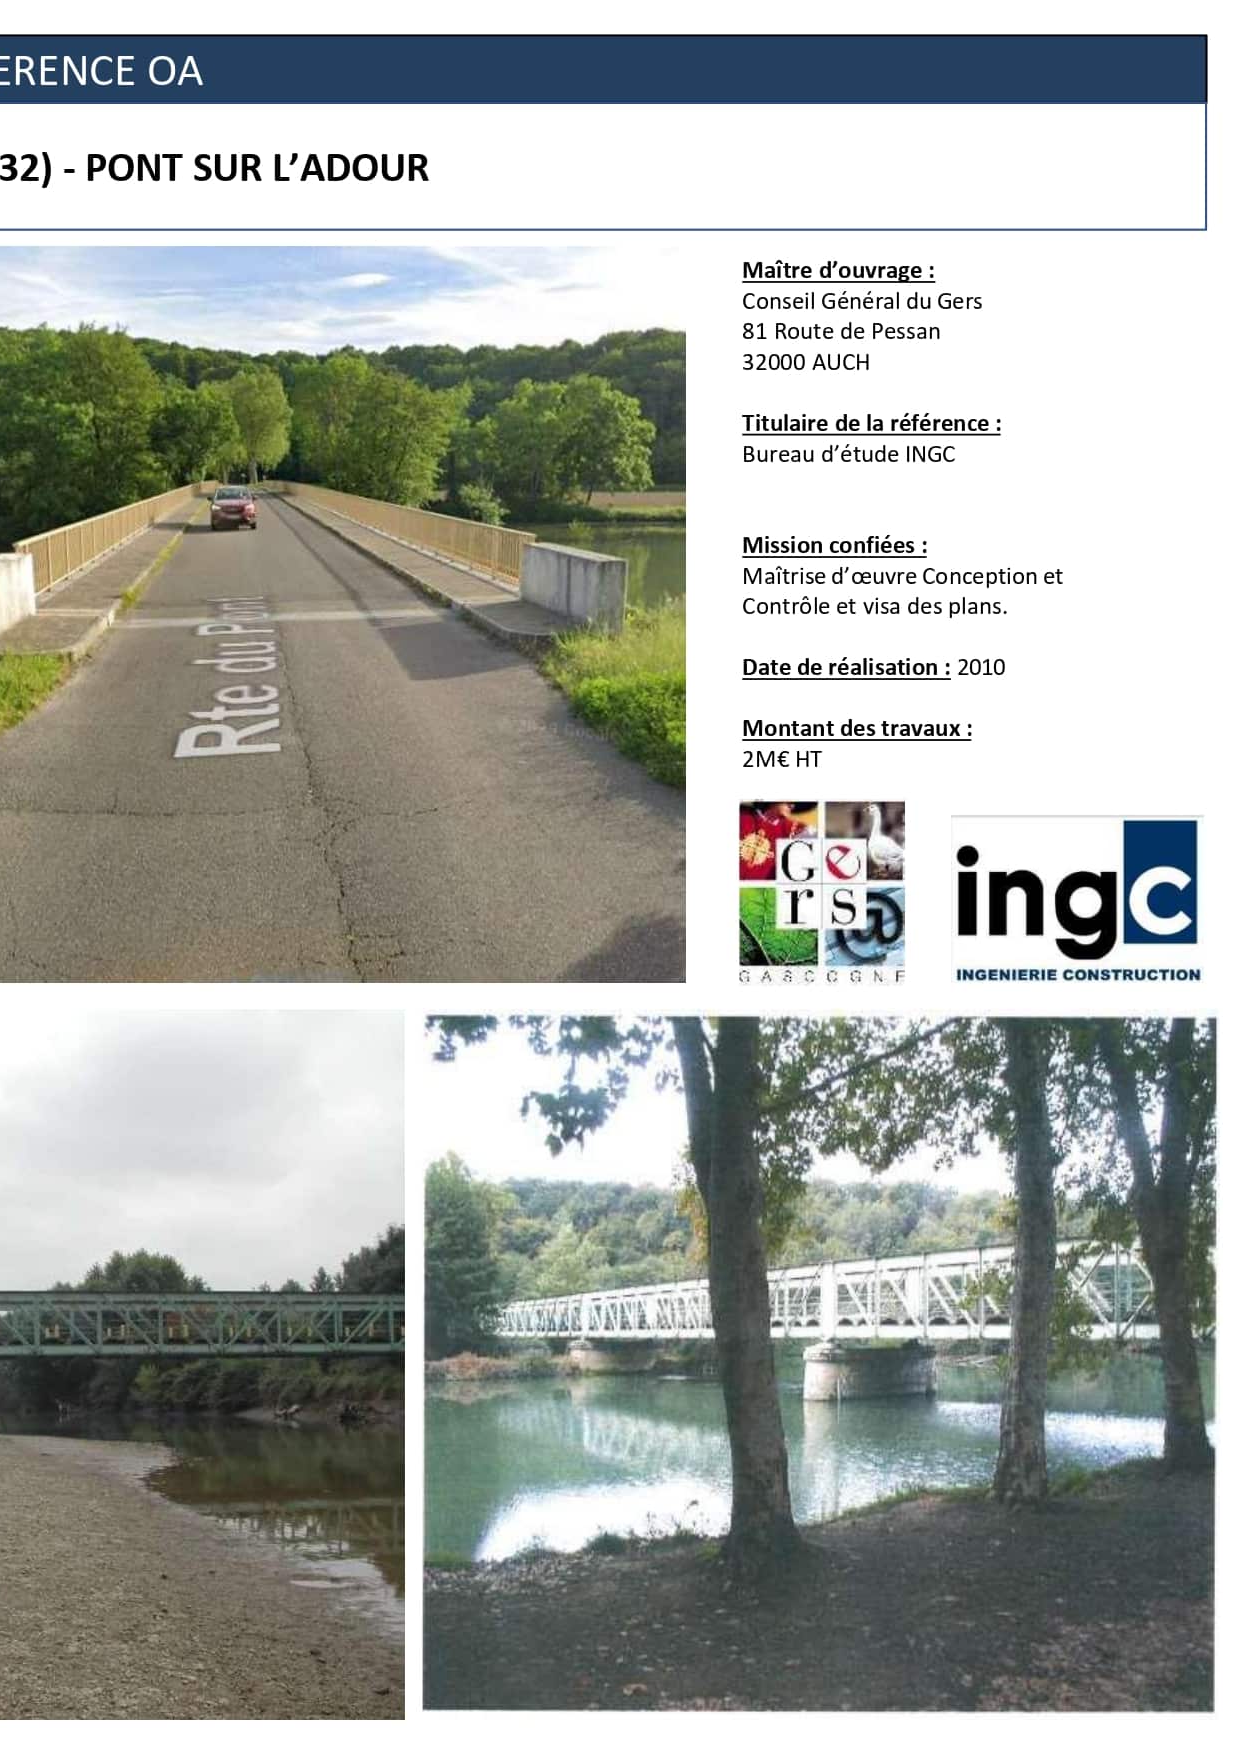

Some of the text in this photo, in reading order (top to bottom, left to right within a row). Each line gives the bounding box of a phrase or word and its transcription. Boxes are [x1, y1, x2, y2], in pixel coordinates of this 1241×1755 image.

[148, 55, 204, 86] OA
[87, 153, 184, 182] PONT
[193, 153, 263, 182] SUR
[274, 152, 430, 182] L’ADOUR
[742, 259, 923, 284] Maître d’ouvrage
[742, 290, 983, 310] Conseil Général du Gers
[742, 321, 941, 340] 81 Route de Pessan
[742, 353, 870, 371] 32000 AUCH
[741, 412, 990, 433] Titulaire de la référence
[743, 443, 956, 463] Bureau d’étude INGC
[742, 534, 915, 555] Mission confiées
[743, 565, 1064, 589] Maîtrise d’œuvre Conception et
[742, 595, 1008, 619] Contrôle et visa des plans.
[742, 656, 1006, 677] Date de réalisation 2010
[743, 718, 961, 738] Montant des travaux
[742, 750, 823, 768] 2M€ HT
[956, 968, 1201, 982] INGENIERIE CONSTRUCTION
